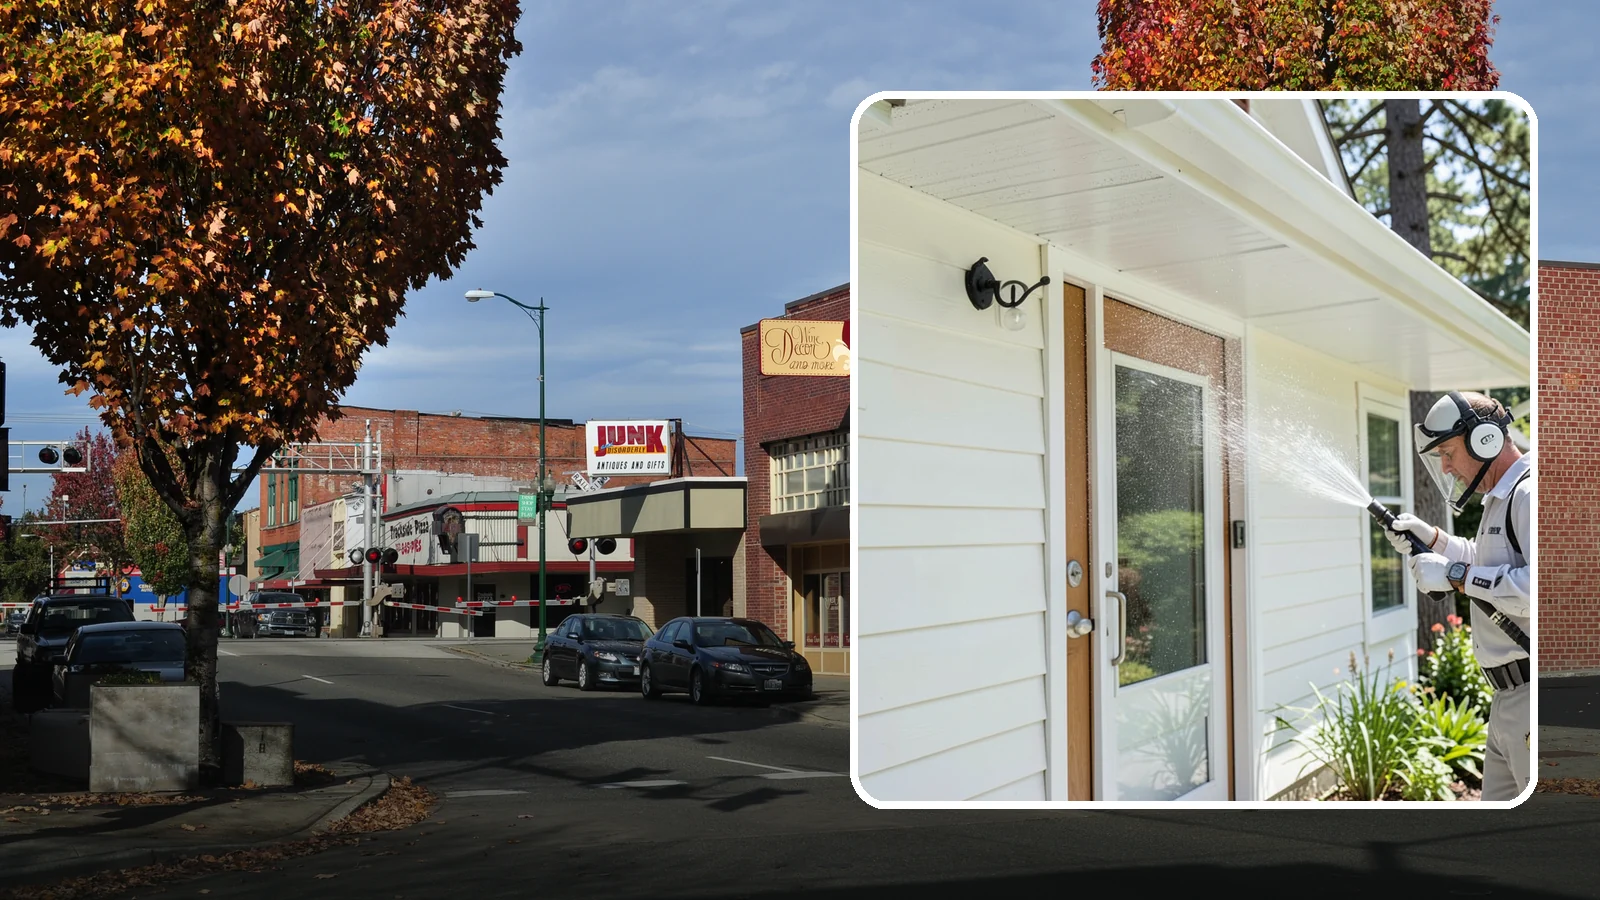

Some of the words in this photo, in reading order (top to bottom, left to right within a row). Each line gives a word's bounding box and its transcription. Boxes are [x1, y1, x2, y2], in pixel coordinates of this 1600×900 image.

[595, 425, 665, 457] JUNK
[607, 446, 646, 454] DISORDERLY
[597, 461, 628, 470] ANTIQUES
[631, 461, 644, 470] AND
[647, 460, 666, 469] GIFTS
[390, 521, 412, 539] Trackside
[414, 519, 429, 534] Pizza
